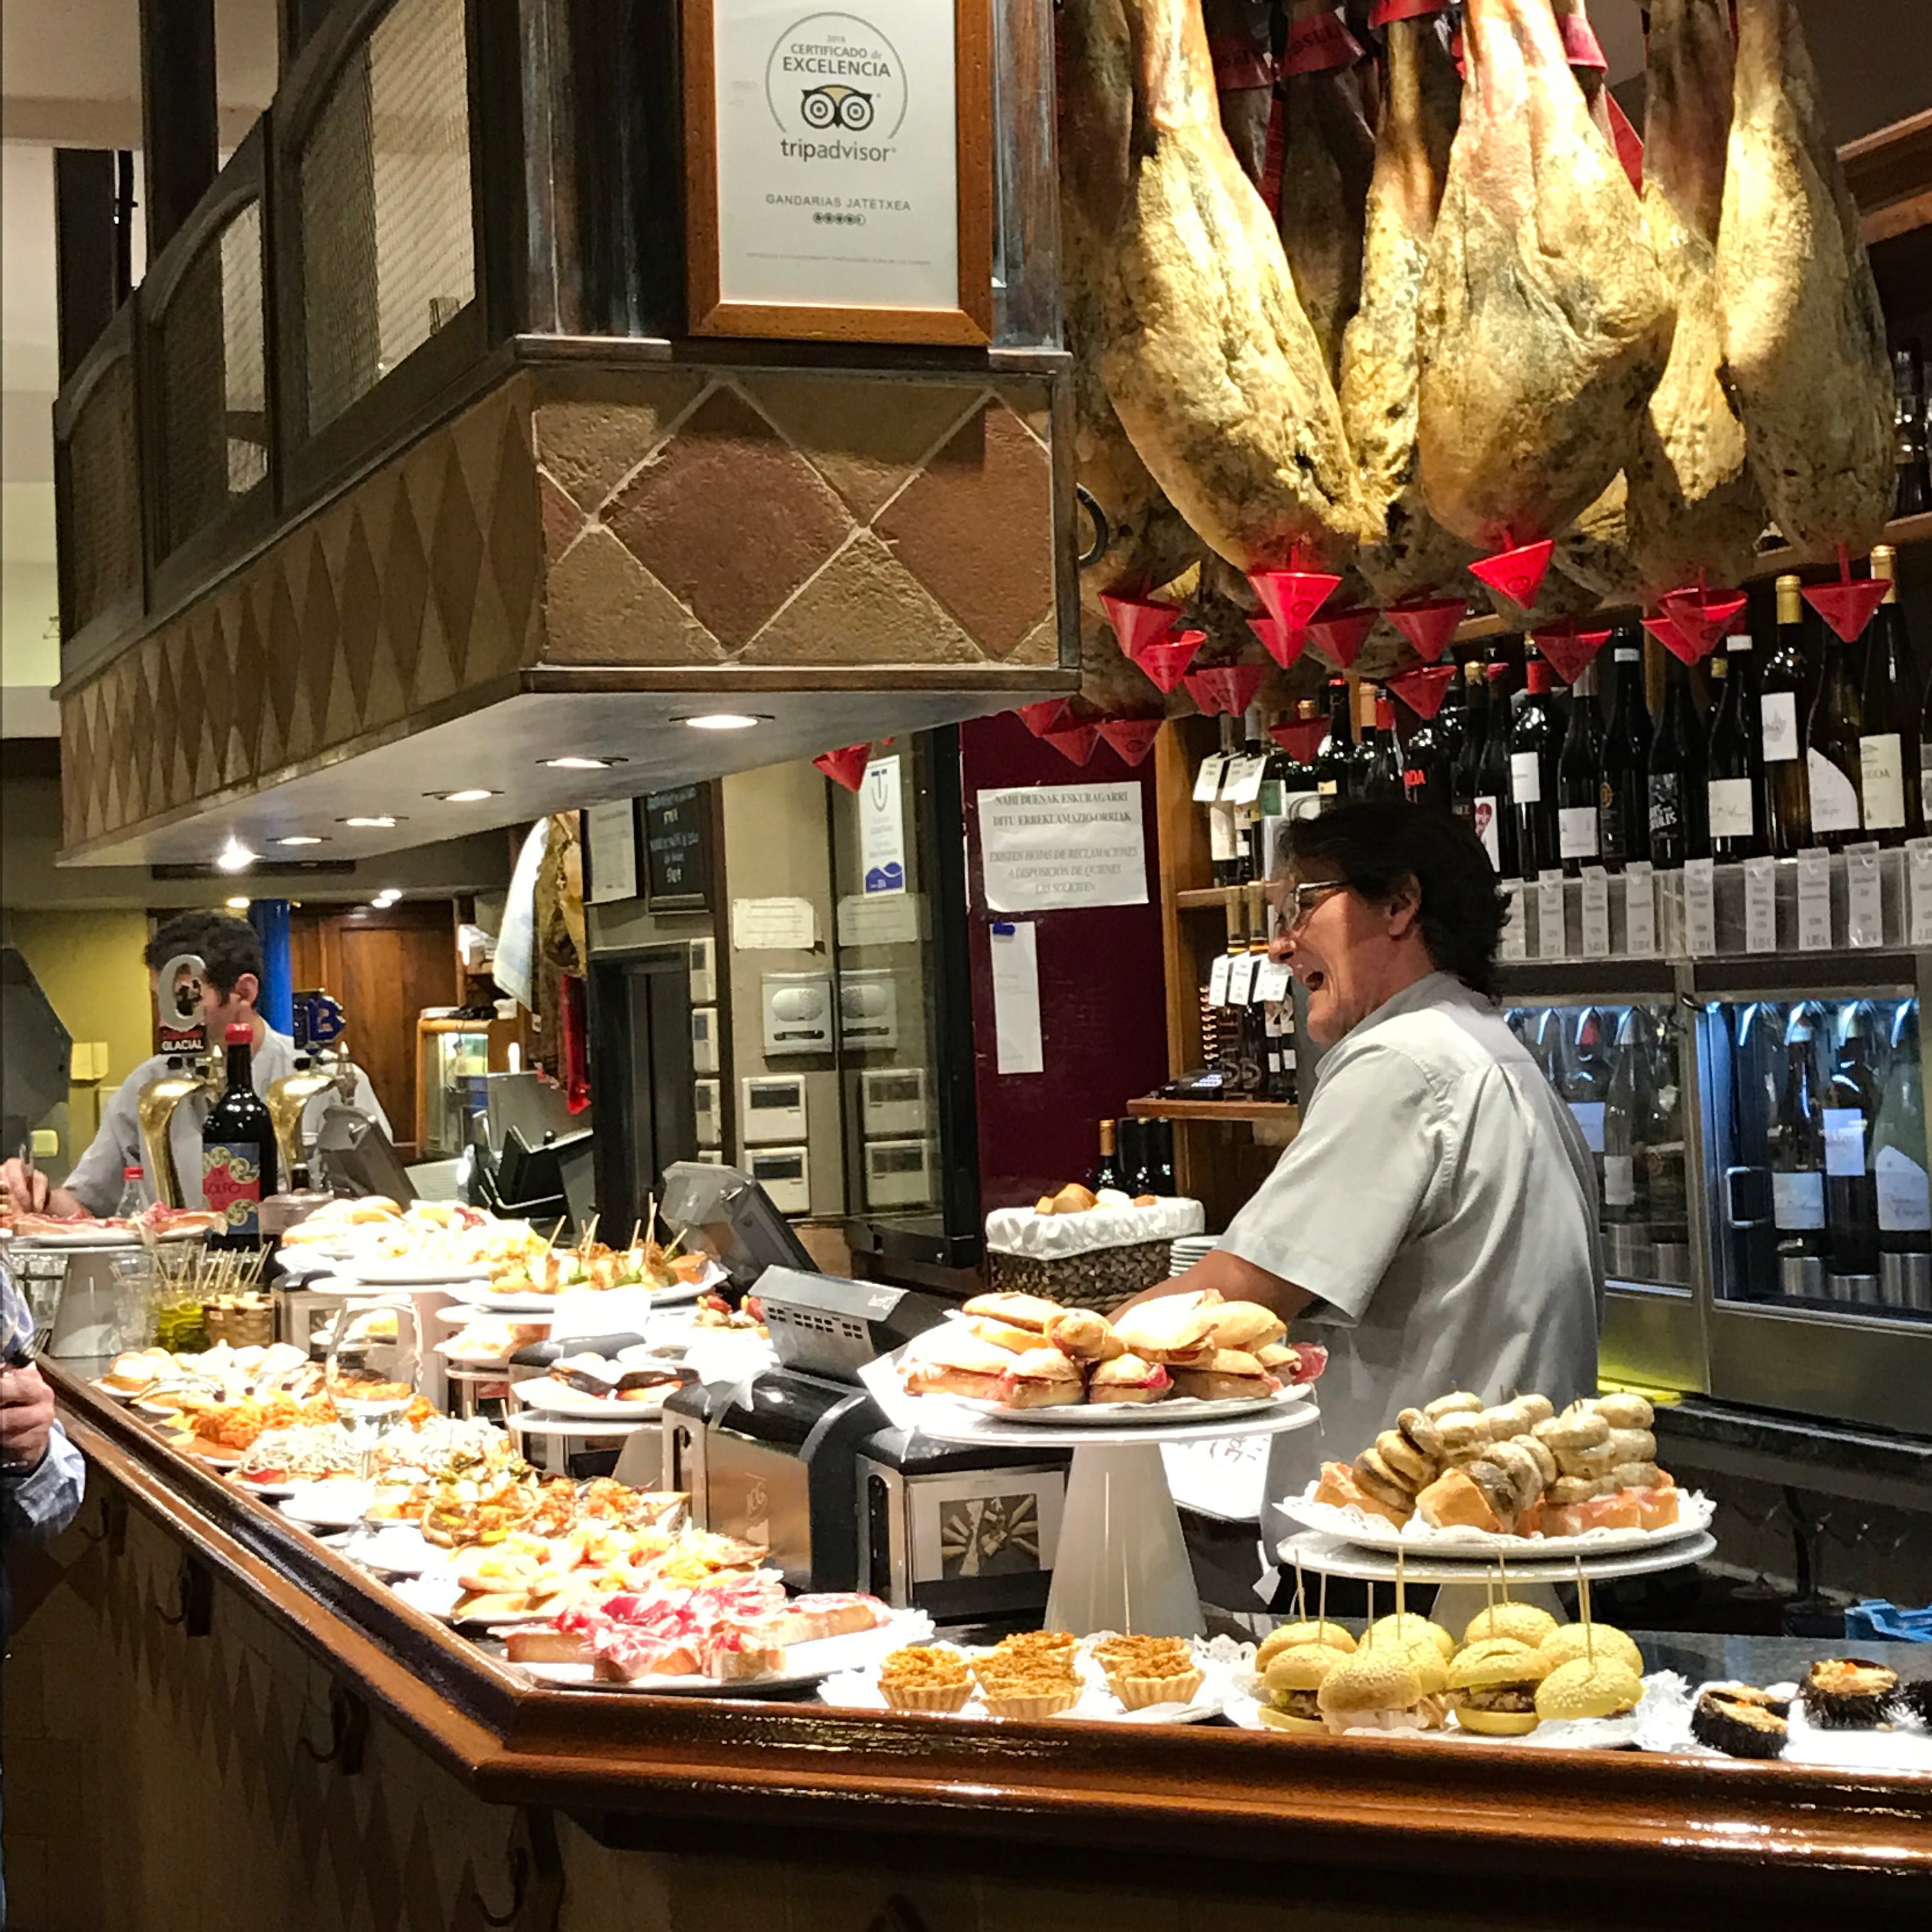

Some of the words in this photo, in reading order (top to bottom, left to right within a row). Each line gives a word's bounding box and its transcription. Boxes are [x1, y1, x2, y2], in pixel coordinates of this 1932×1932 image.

[791, 43, 867, 59] CERTIFICADO
[871, 50, 882, 59] de
[783, 56, 891, 77] EXCELENCIA
[781, 138, 890, 162] tripadvisor
[766, 194, 842, 207] GANDARIAS
[846, 198, 911, 211] JATETXEA
[1054, 849, 1066, 860] DE
[1071, 865, 1083, 876] DE
[162, 1039, 204, 1051] GLACIAL
